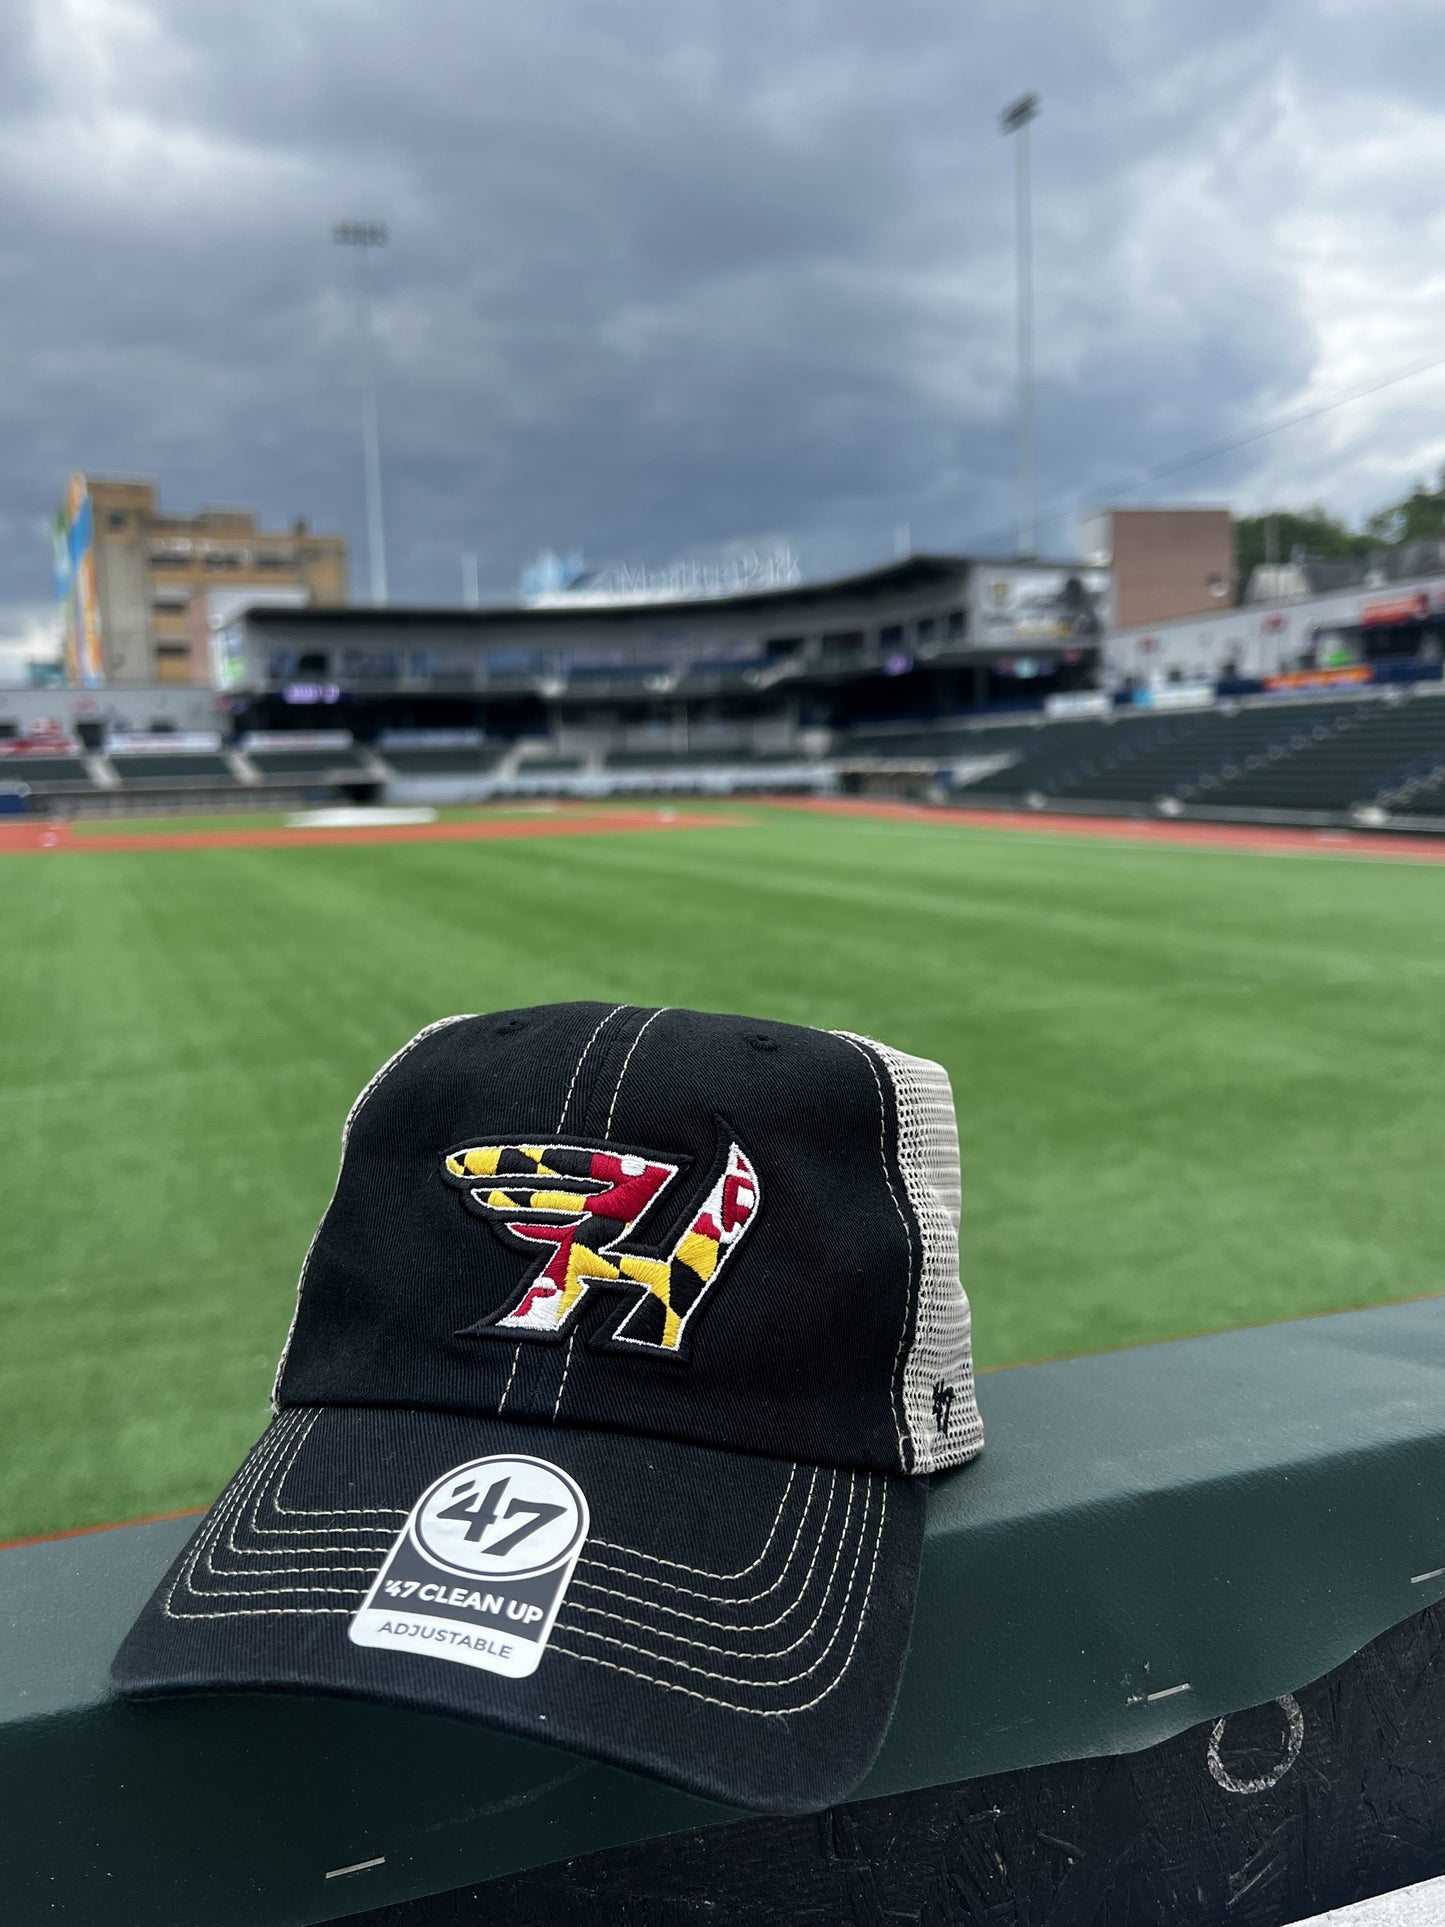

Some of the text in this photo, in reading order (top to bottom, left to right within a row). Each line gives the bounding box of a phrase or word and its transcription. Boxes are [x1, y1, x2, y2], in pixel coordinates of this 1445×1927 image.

[418, 1583, 505, 1616] CLEAN
[505, 1600, 545, 1625] UP
[376, 1620, 514, 1660] ADJUSTABLE
